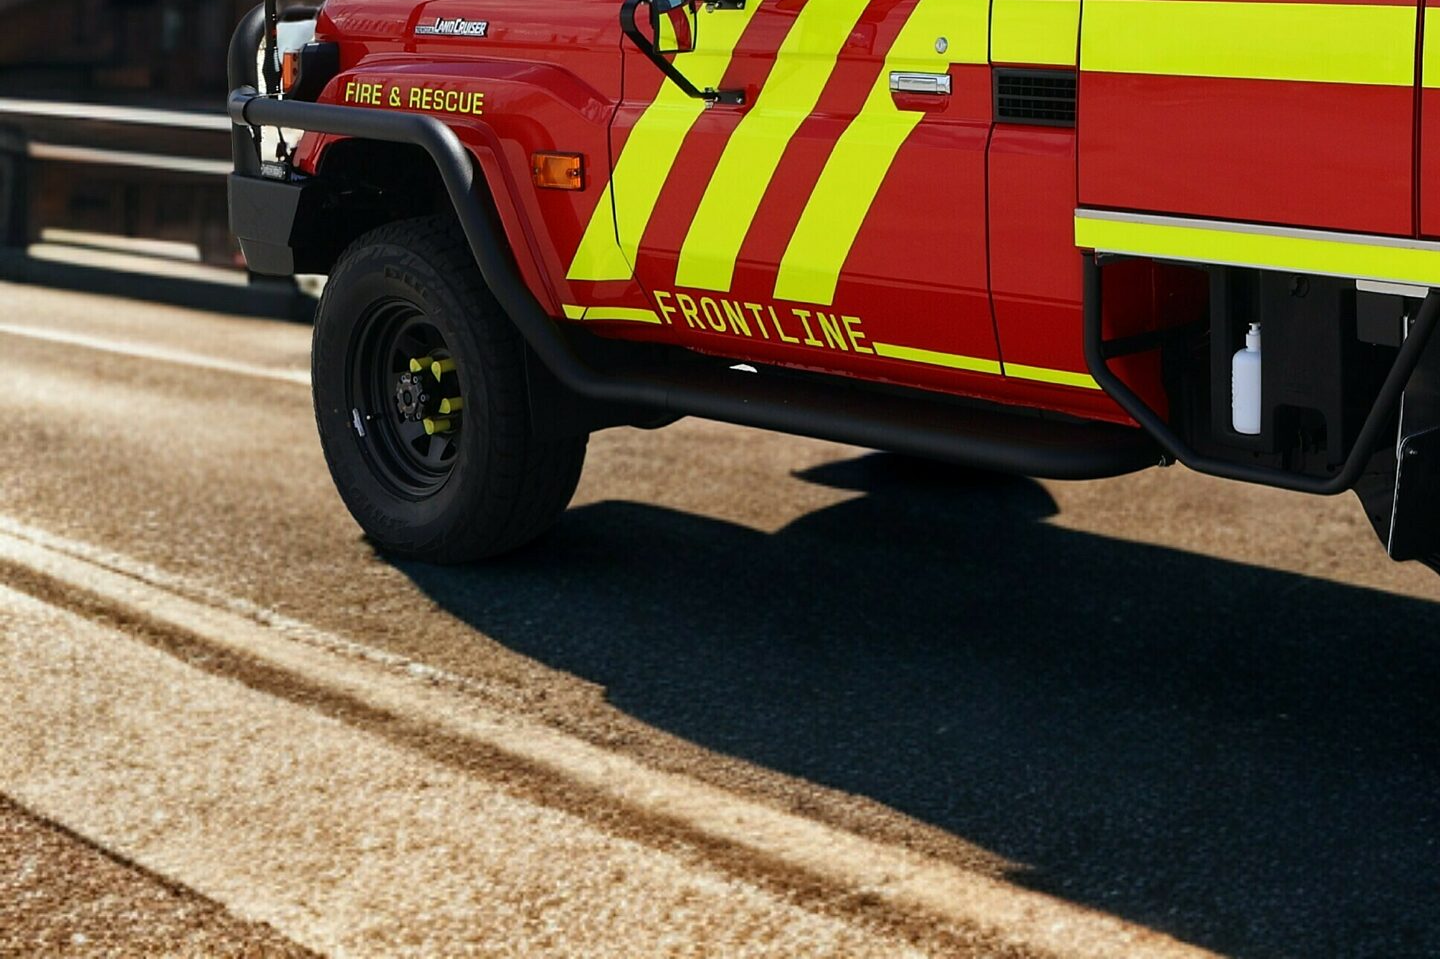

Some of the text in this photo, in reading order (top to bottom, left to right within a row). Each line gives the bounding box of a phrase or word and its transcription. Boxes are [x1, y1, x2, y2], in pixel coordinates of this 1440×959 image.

[345, 82, 484, 115] FIRE & RESCUE
[653, 290, 874, 354] FRONTLINE
